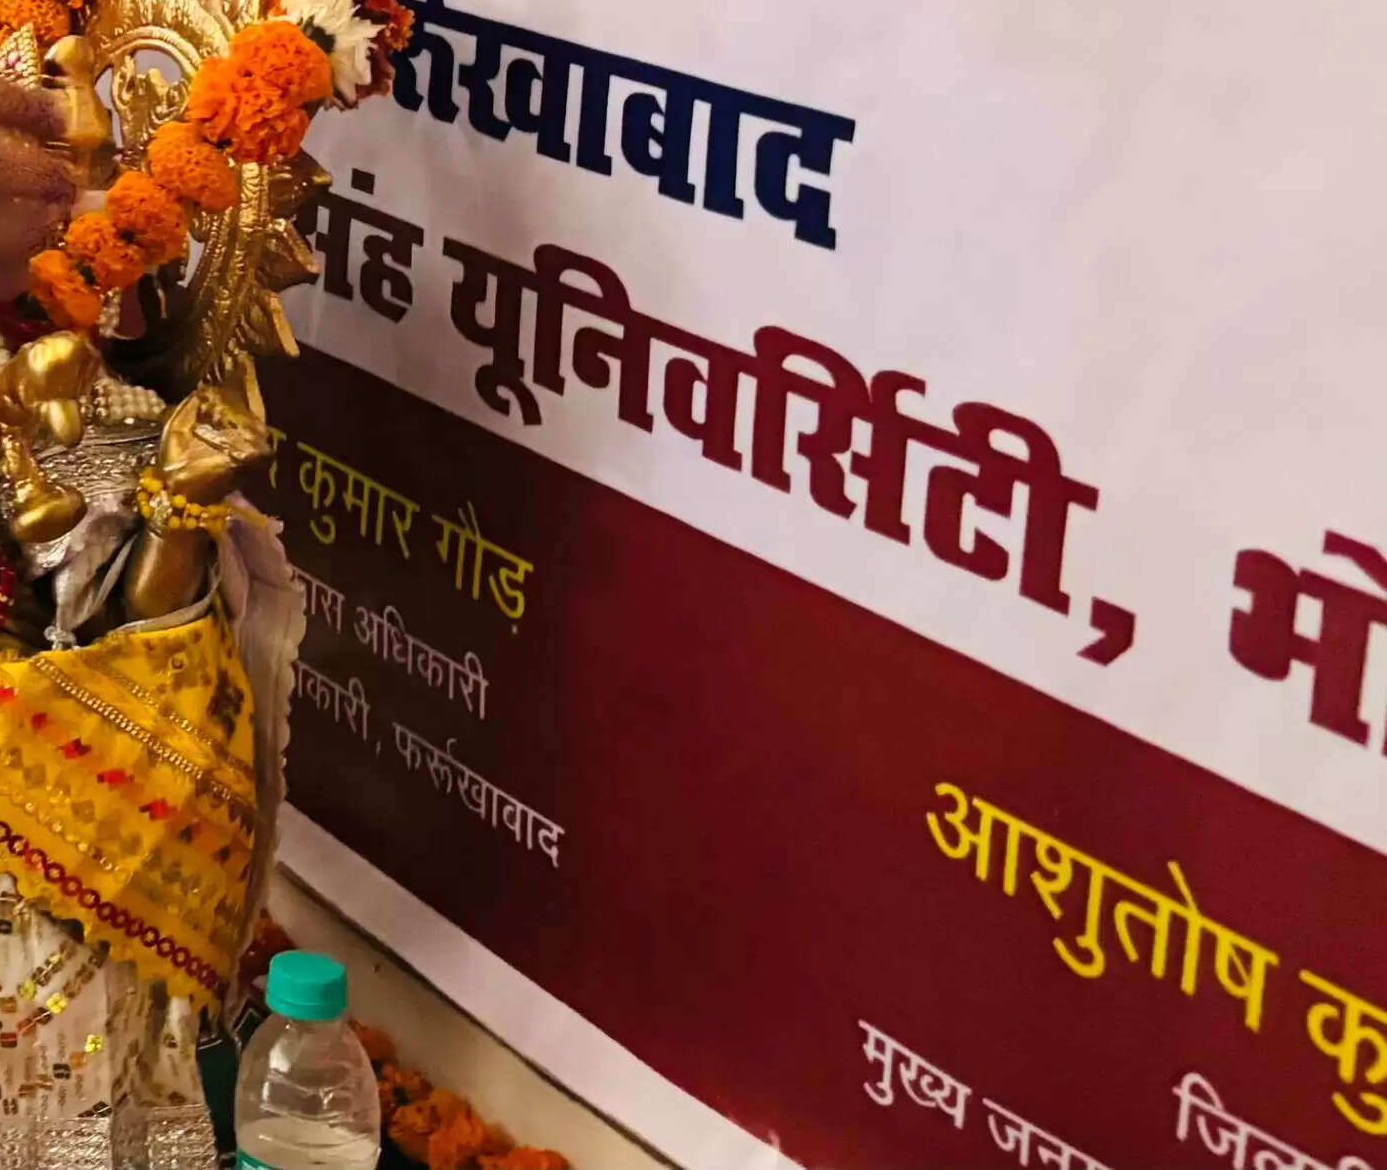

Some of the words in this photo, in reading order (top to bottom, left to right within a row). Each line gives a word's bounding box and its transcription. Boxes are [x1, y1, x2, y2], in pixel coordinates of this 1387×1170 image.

[297, 440, 421, 560] कुमार
[431, 500, 535, 635] गौड़
[352, 604, 490, 720] अधिकारी
[926, 782, 1280, 1033] आशुतोष
[857, 1018, 973, 1130] मुख्य
